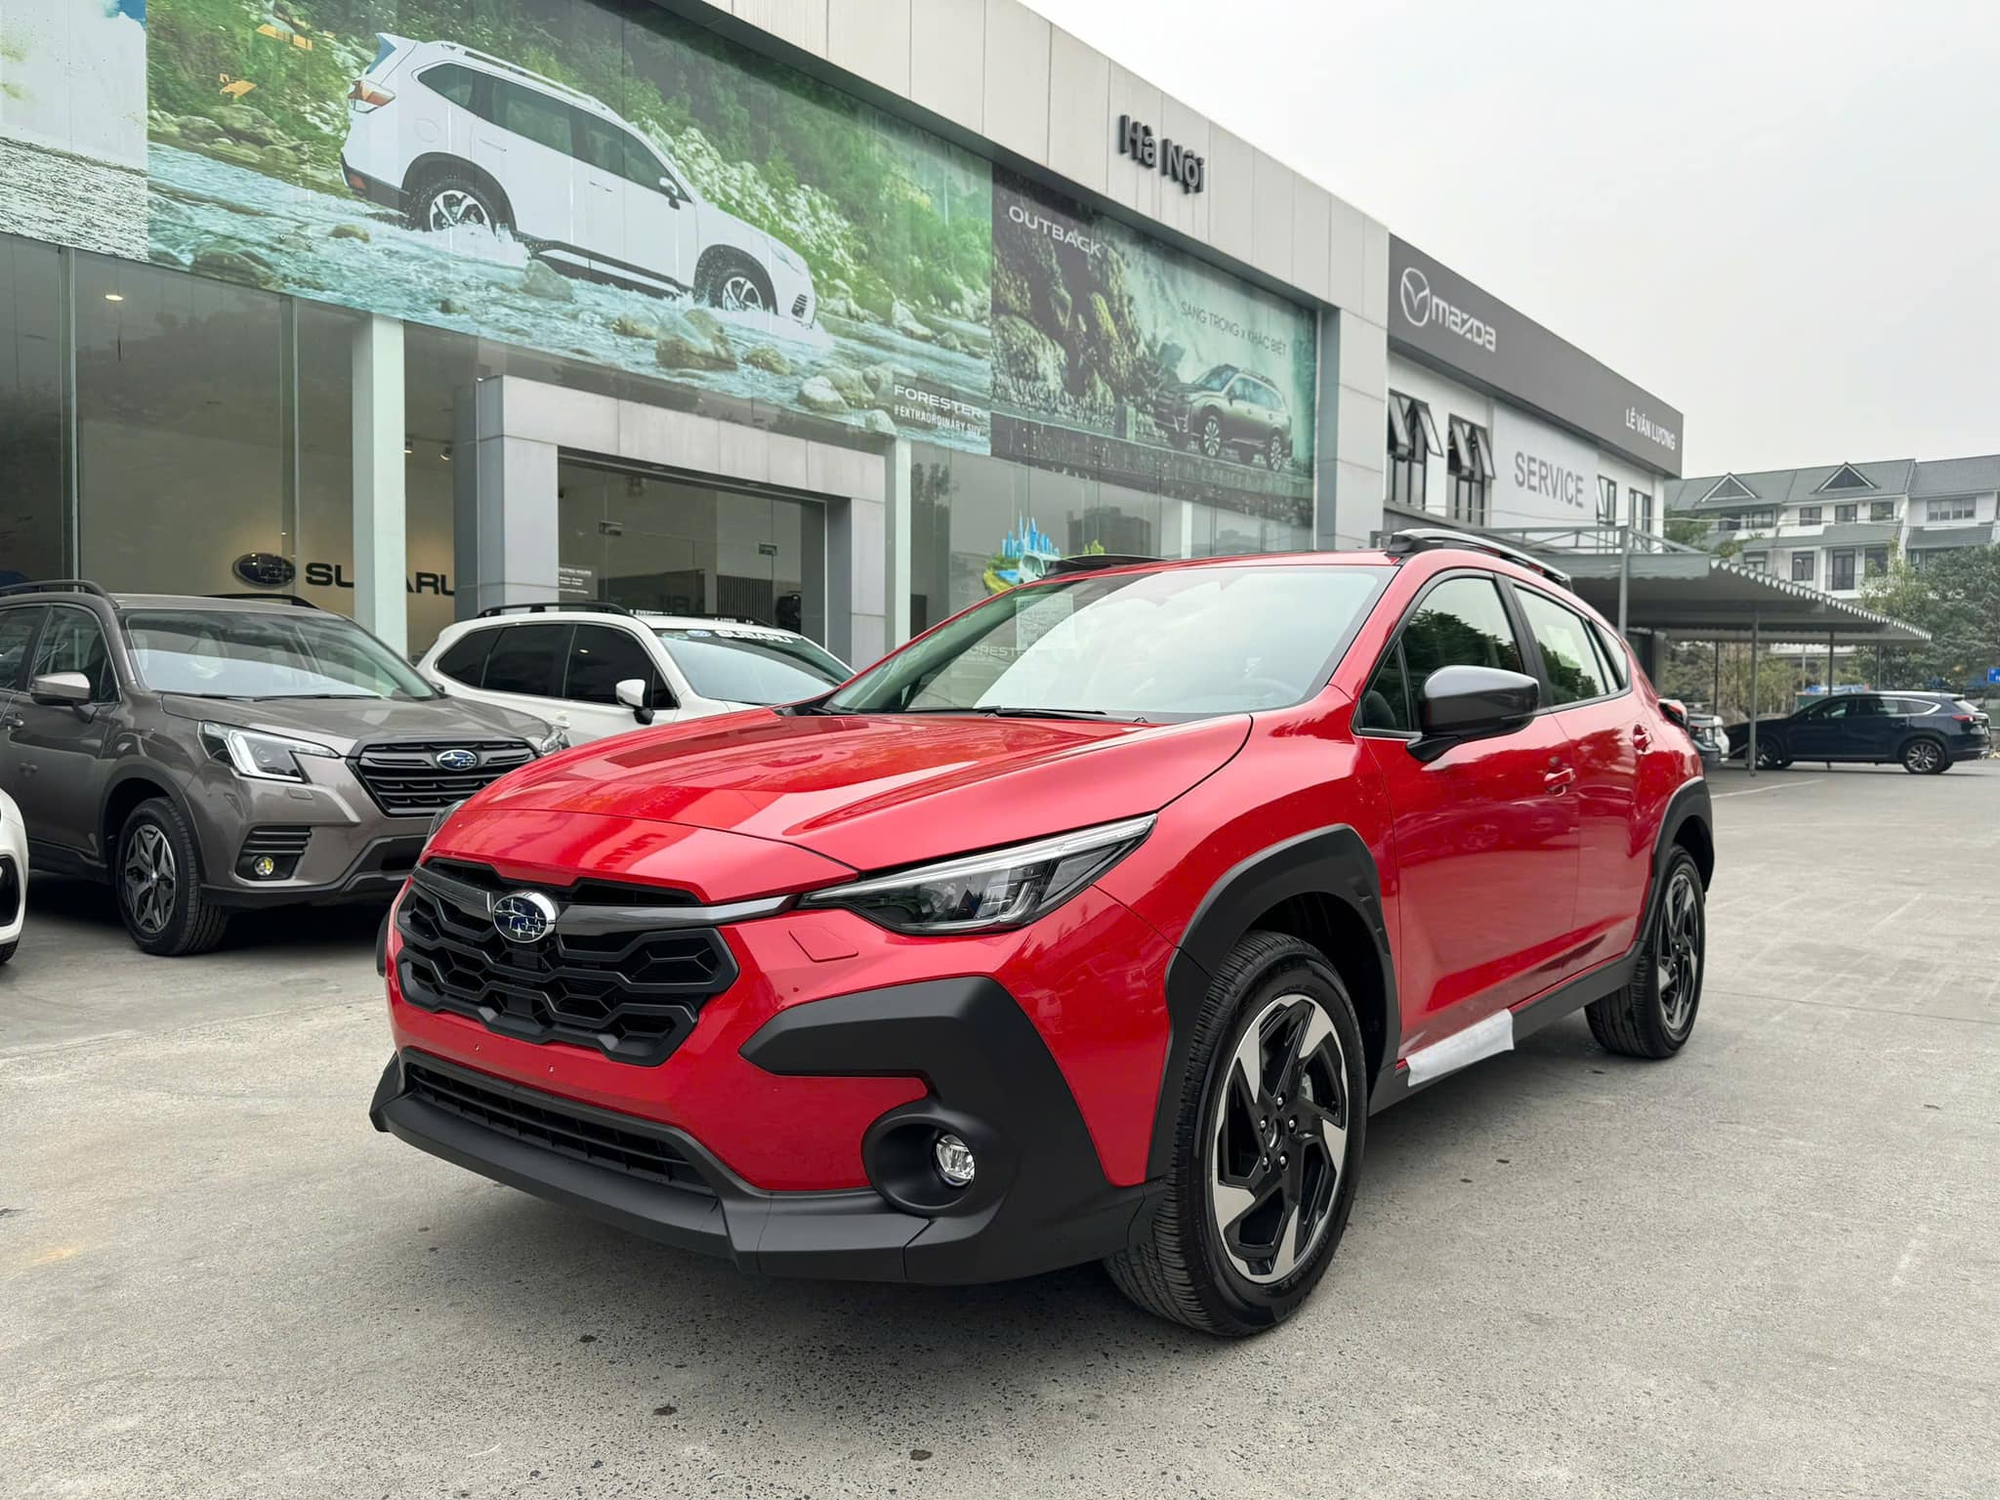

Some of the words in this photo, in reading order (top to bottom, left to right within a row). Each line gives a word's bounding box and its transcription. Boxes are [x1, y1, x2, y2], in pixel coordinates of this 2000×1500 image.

[1119, 115, 1157, 169] Hà
[1160, 138, 1204, 194] Nội
[1009, 206, 1101, 258] OUTBACK
[1180, 300, 1206, 323] SANG
[1432, 295, 1495, 352] mazda
[894, 384, 982, 418] FORESTER
[1514, 451, 1584, 508] SERVICE
[714, 629, 794, 645] SUBARU
